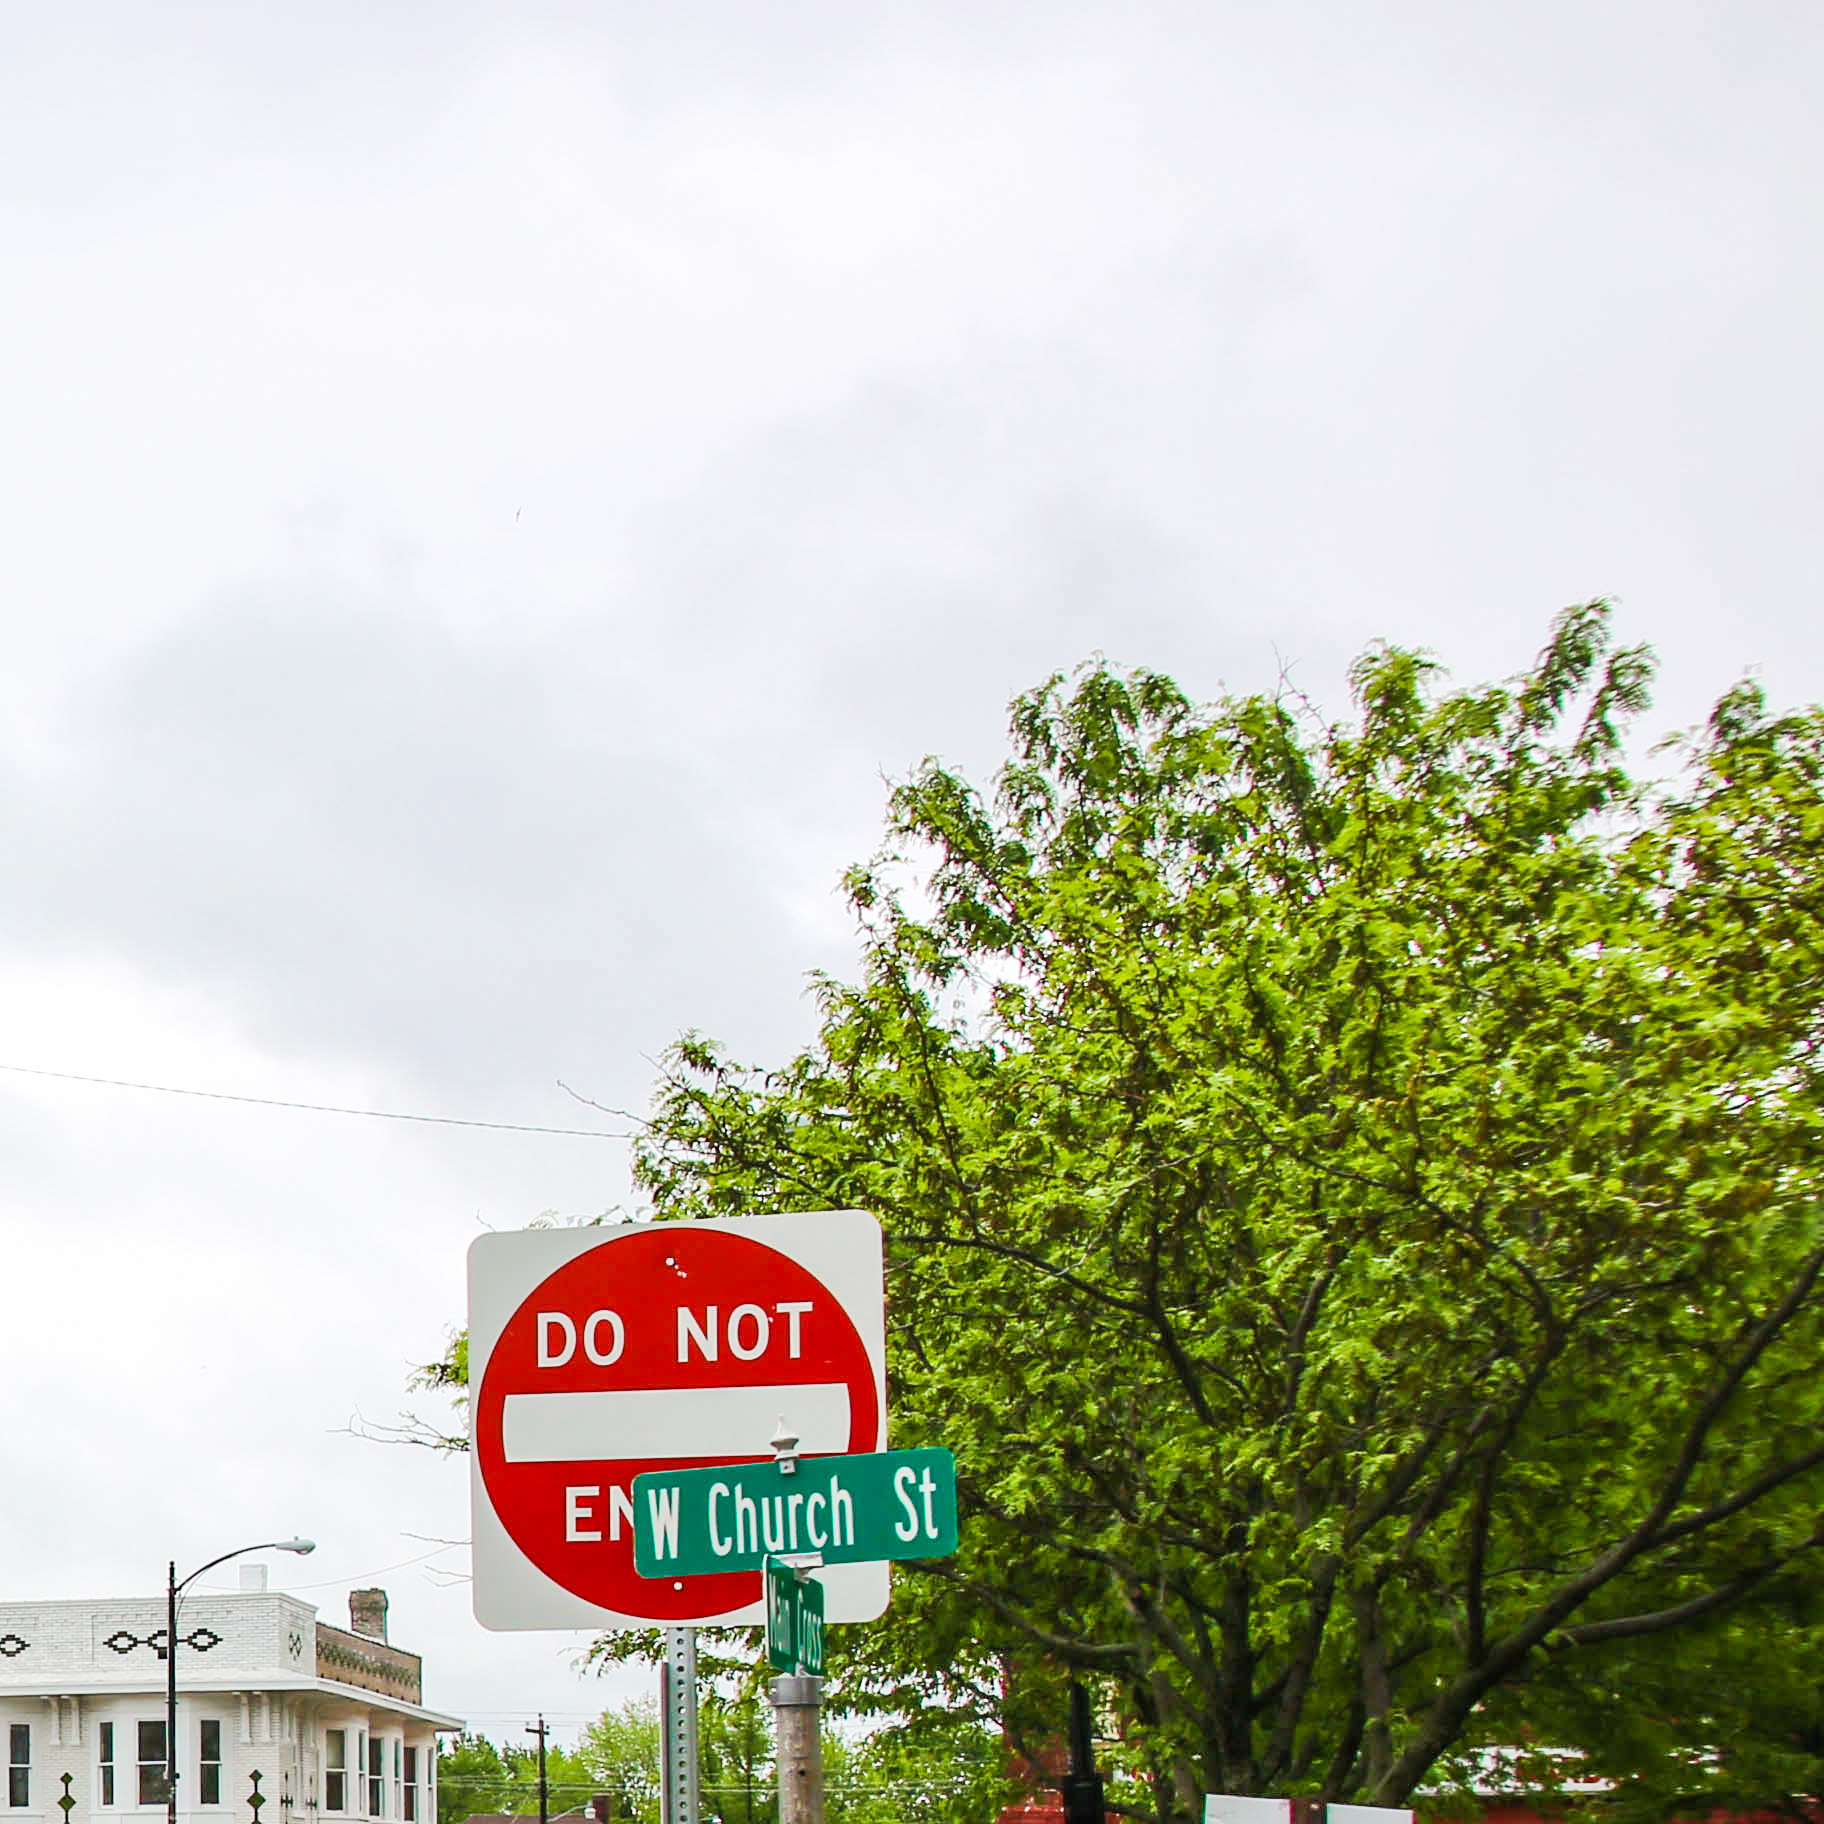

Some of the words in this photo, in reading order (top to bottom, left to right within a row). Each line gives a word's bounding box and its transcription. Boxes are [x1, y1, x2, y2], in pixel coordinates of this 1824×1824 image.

[537, 1309, 625, 1368] DO
[677, 1302, 813, 1363] NOT
[648, 1486, 680, 1560] W
[708, 1475, 855, 1556] Church
[893, 1466, 938, 1542] St
